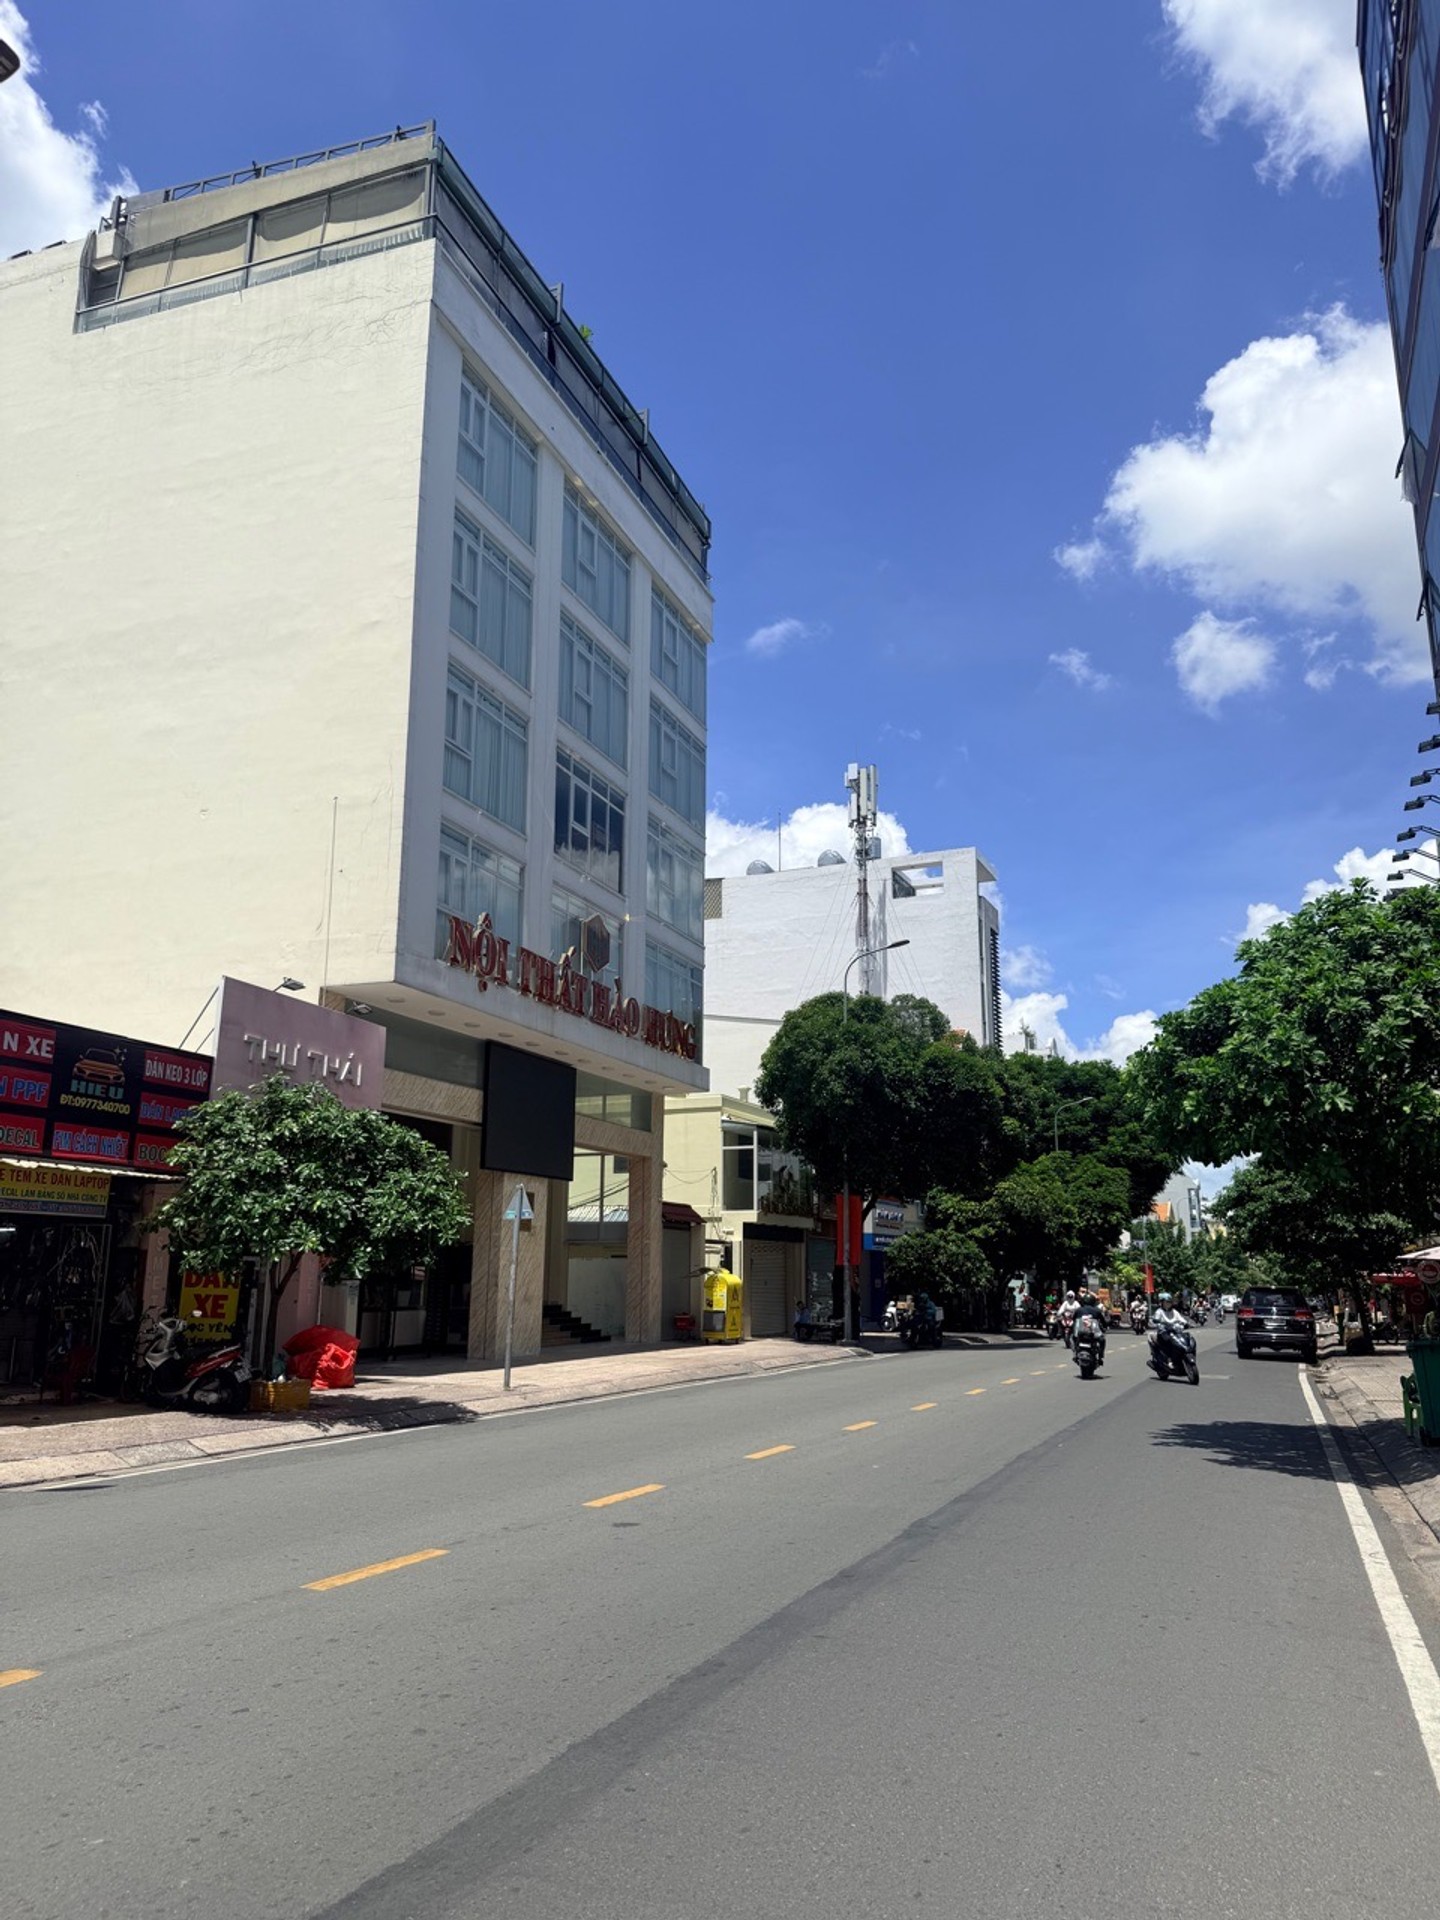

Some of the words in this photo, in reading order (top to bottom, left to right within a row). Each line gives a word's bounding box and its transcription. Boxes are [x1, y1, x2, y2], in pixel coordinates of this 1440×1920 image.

[449, 912, 511, 992] NỘI
[517, 946, 588, 1016] THẤT
[25, 1035, 55, 1059] XE
[243, 1034, 301, 1071] THƯ
[307, 1050, 362, 1086] THÁI
[145, 1056, 165, 1079] DÁN
[184, 1067, 190, 1084] 3
[12, 1077, 49, 1103] PPF
[73, 1128, 99, 1154] CÁCH
[9, 1168, 31, 1182] TEM
[35, 1170, 46, 1184] XE
[74, 1174, 110, 1189] LAPTOP
[191, 1294, 229, 1319] XE
